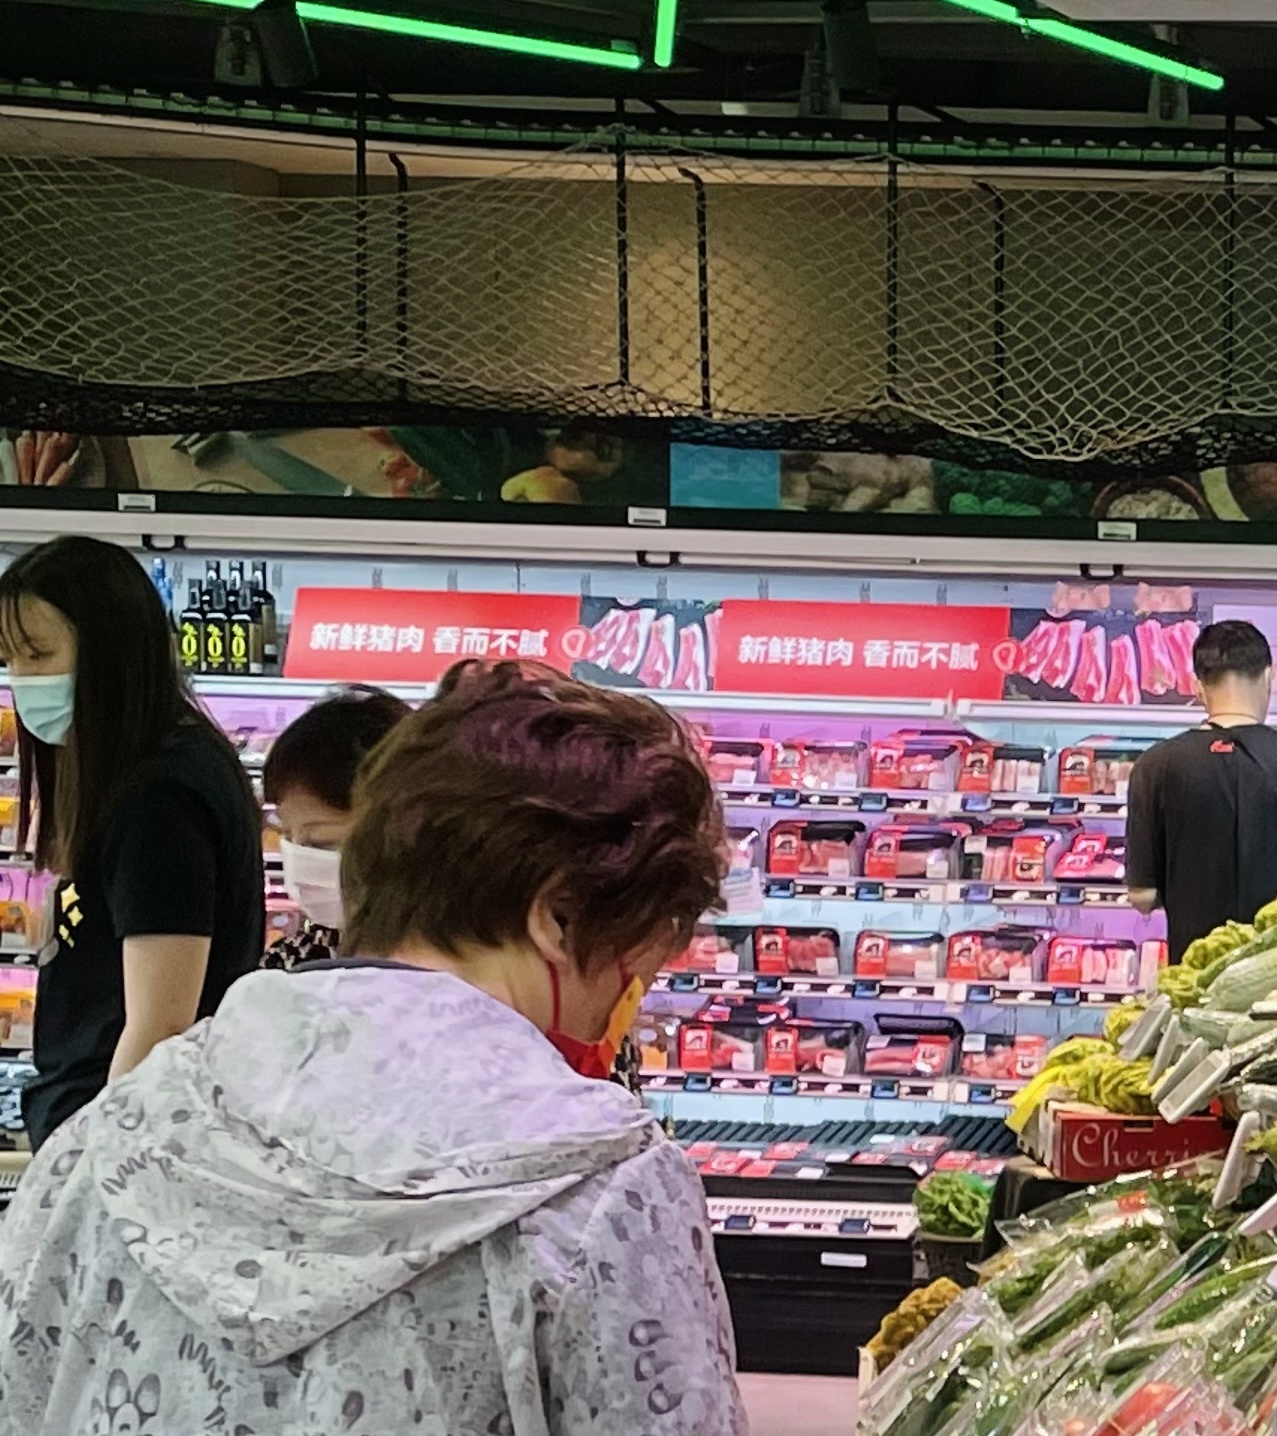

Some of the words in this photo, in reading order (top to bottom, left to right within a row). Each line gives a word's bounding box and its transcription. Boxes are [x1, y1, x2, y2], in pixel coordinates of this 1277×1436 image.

[309, 621, 425, 653] 新鲜猪肉
[433, 626, 549, 658] 香而不腻
[738, 634, 854, 666] 新鲜猪肉
[863, 639, 979, 672] 香而不腻
